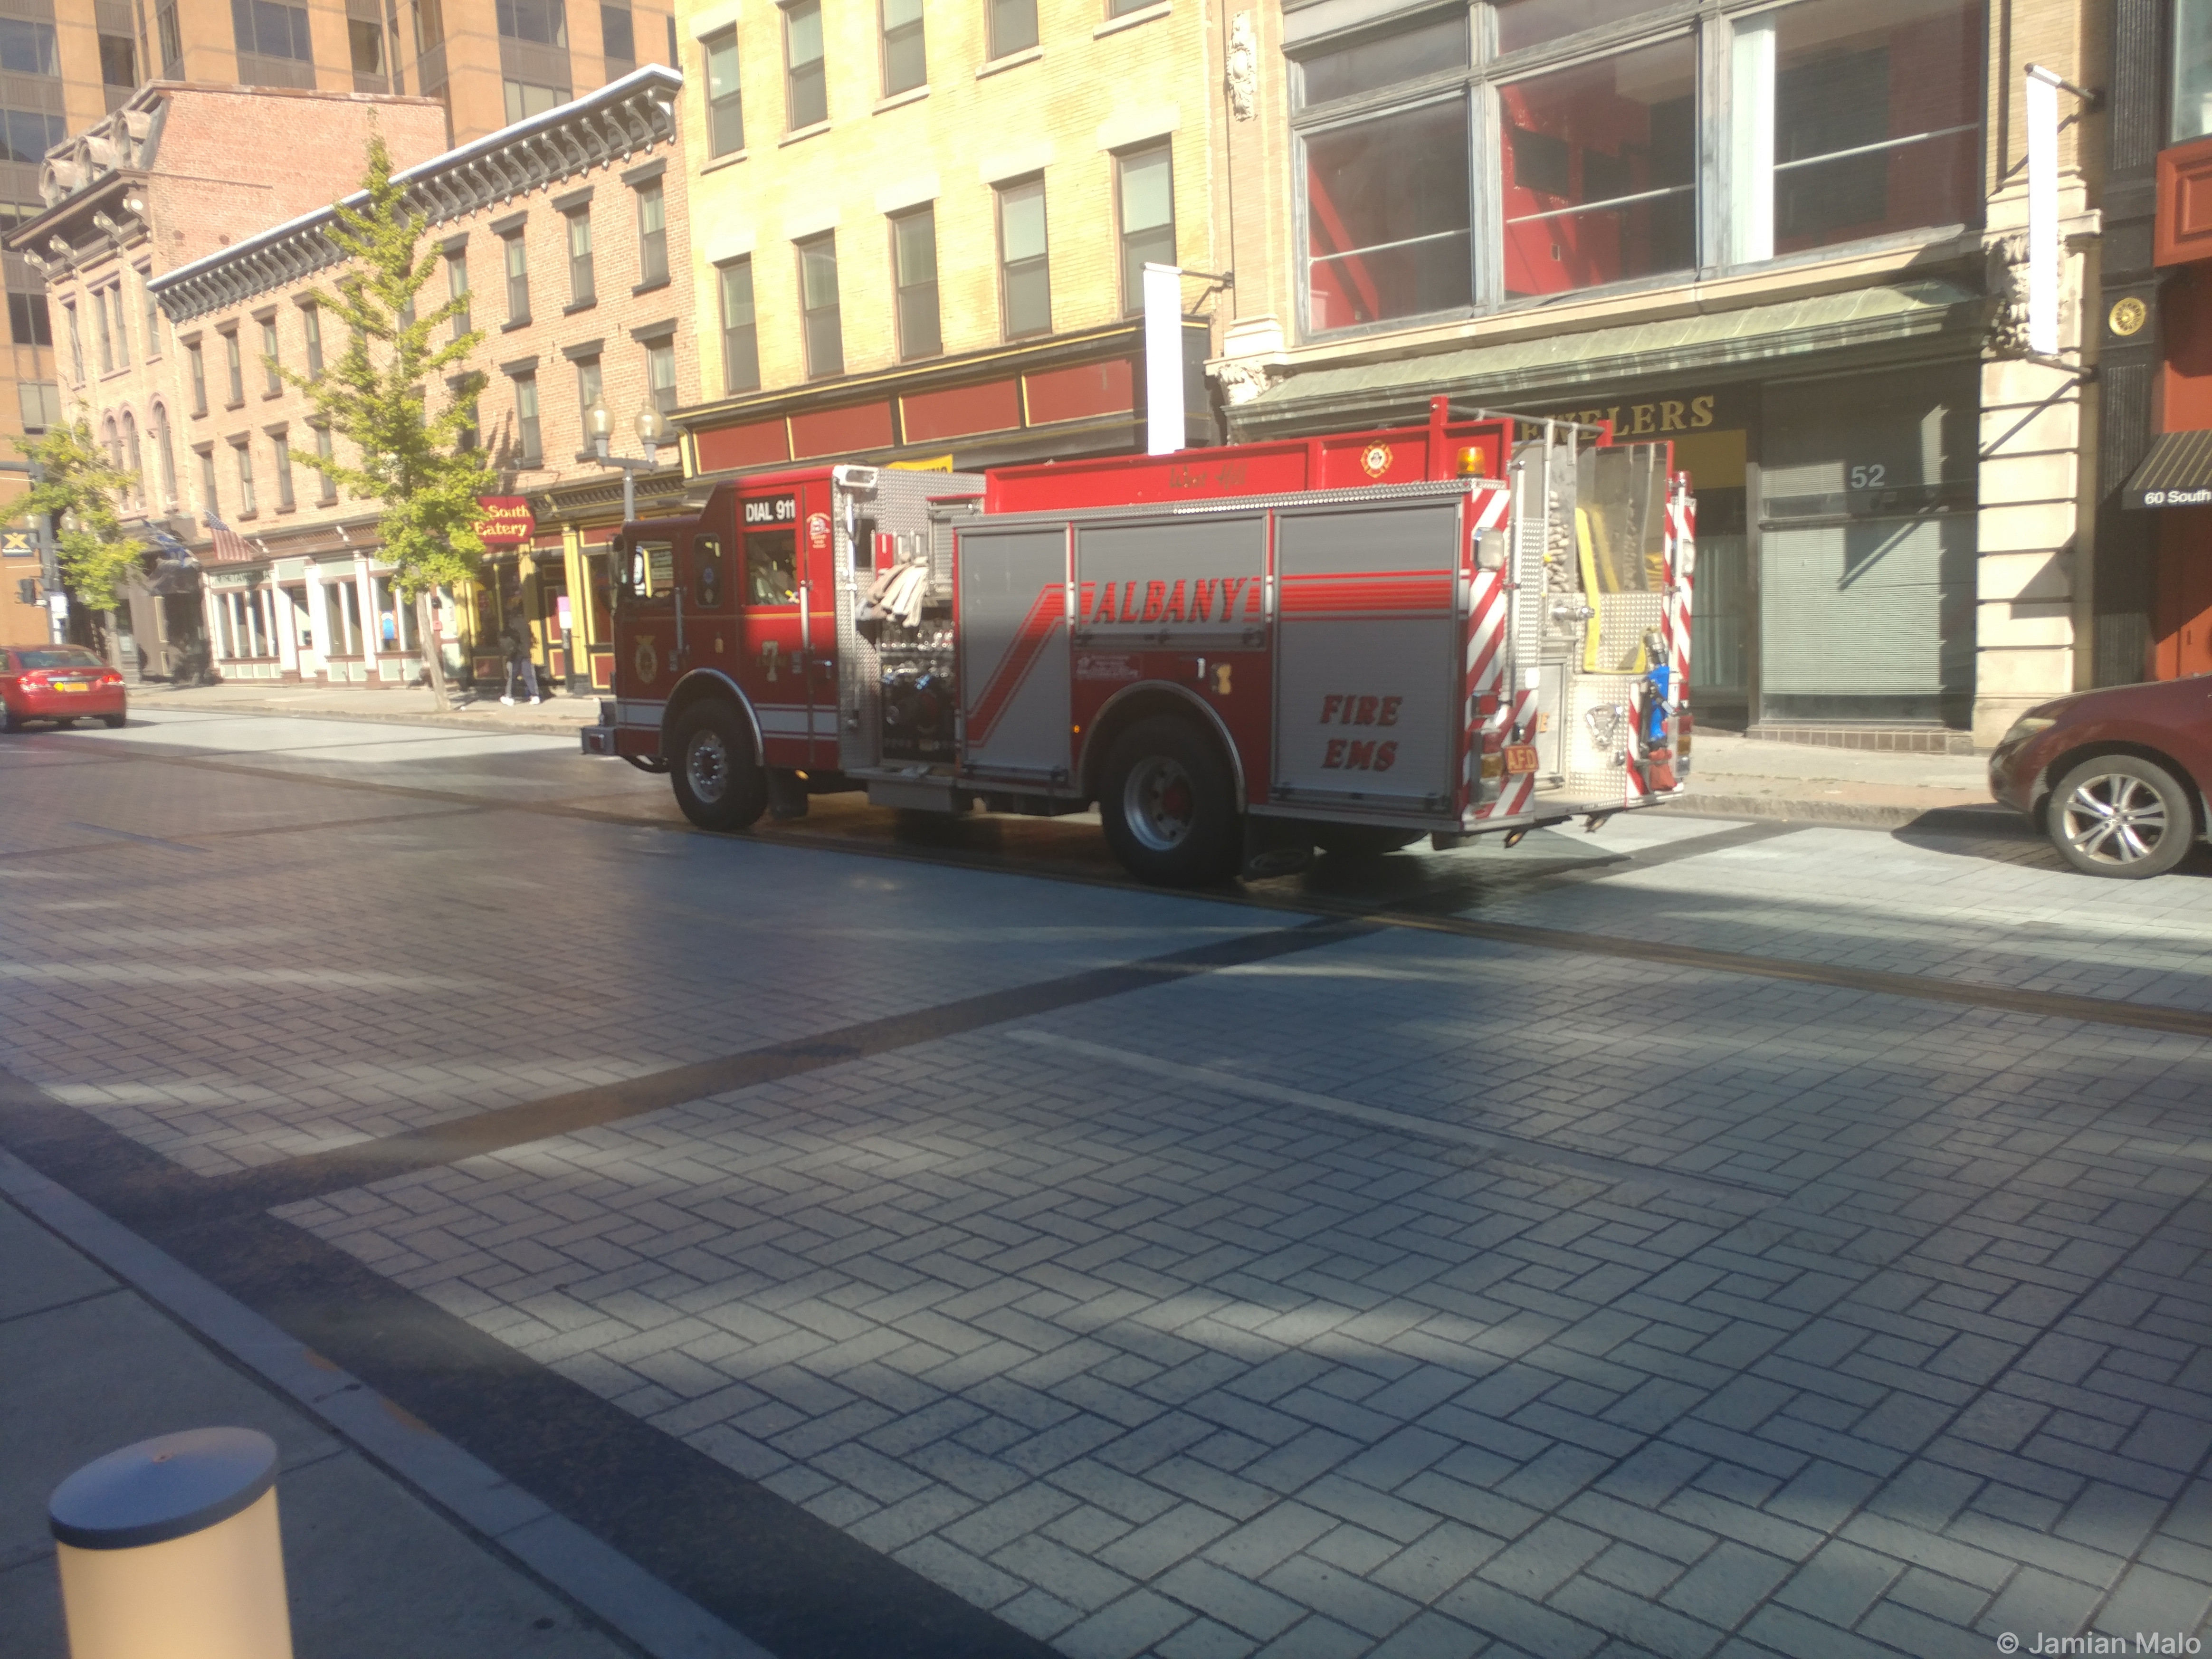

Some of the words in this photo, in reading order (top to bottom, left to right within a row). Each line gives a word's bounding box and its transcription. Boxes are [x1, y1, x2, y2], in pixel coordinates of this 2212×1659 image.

[1522, 394, 1714, 444] EWELERS
[1851, 464, 1885, 488] 52
[488, 504, 531, 517] South
[745, 502, 774, 522] DIAL
[776, 499, 796, 520] 911
[2145, 491, 2164, 505] 60
[2167, 489, 2212, 504] South
[474, 520, 527, 537] Eatery
[1092, 577, 1248, 624] ALBANY
[761, 640, 779, 682] 7
[1320, 694, 1403, 725] FIRE
[1321, 739, 1399, 772] EMS
